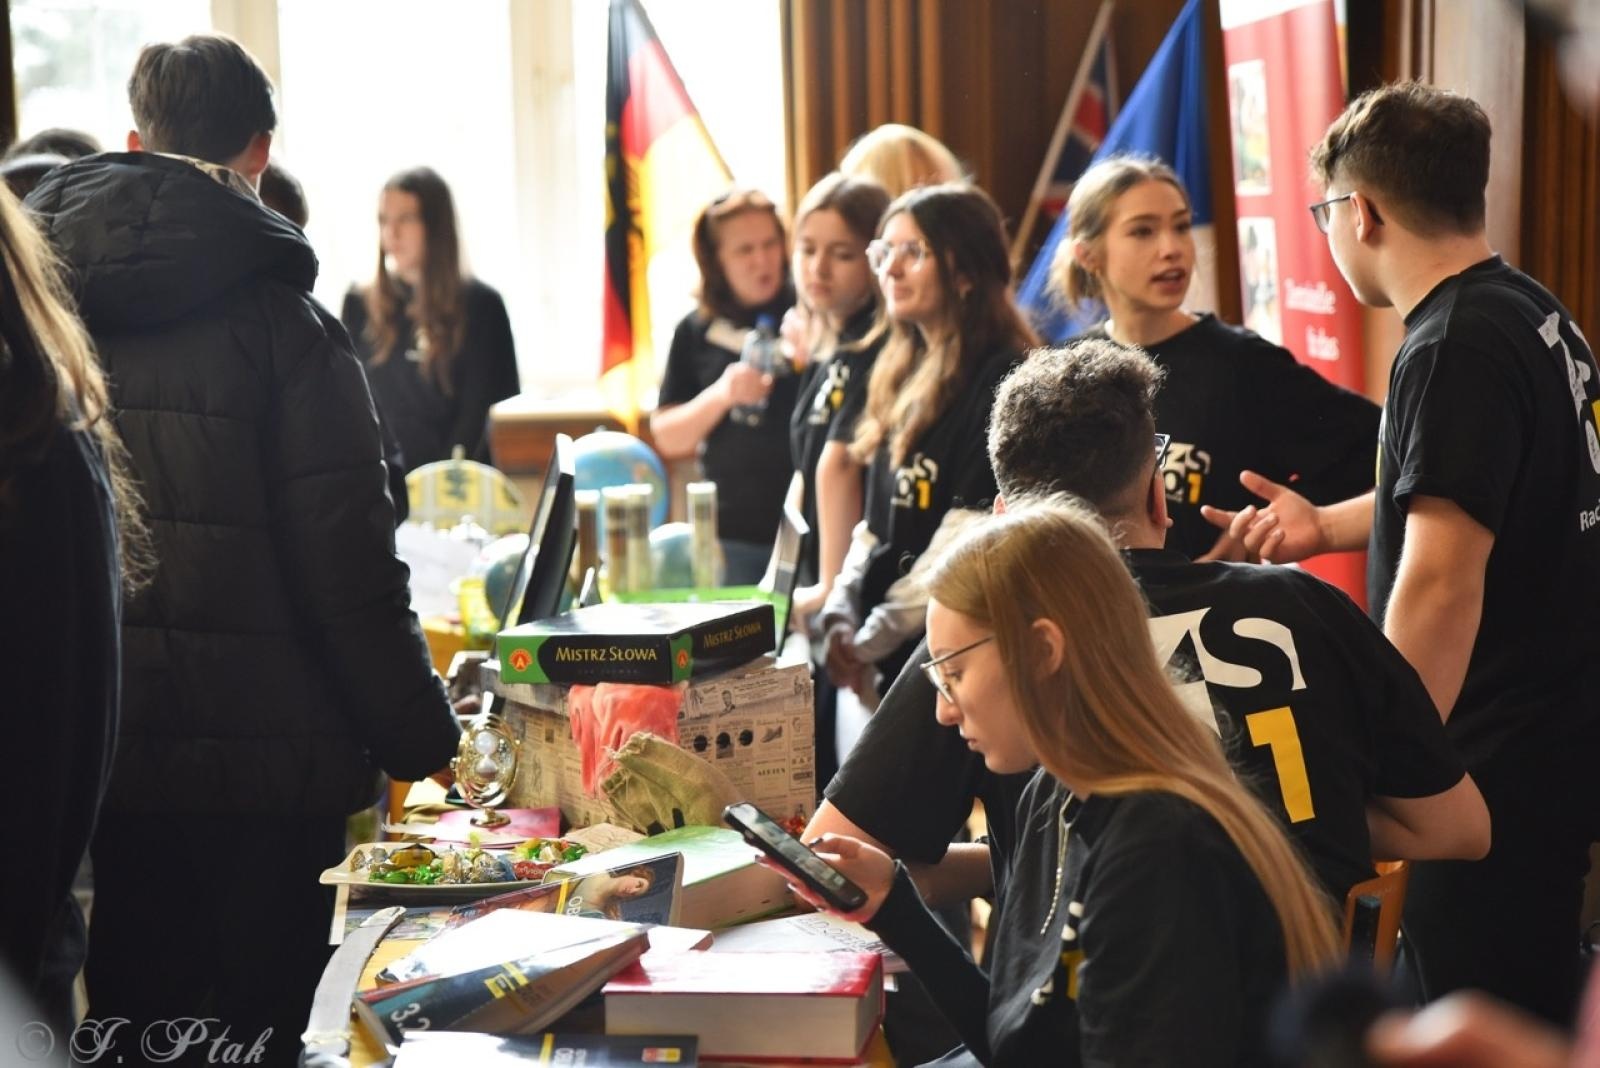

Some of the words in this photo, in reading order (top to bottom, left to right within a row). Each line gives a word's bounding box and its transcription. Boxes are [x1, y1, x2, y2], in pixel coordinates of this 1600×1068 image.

[1580, 498, 1600, 532] Rac
[556, 647, 606, 662] MISTRZ
[609, 645, 657, 661] SŁOWA
